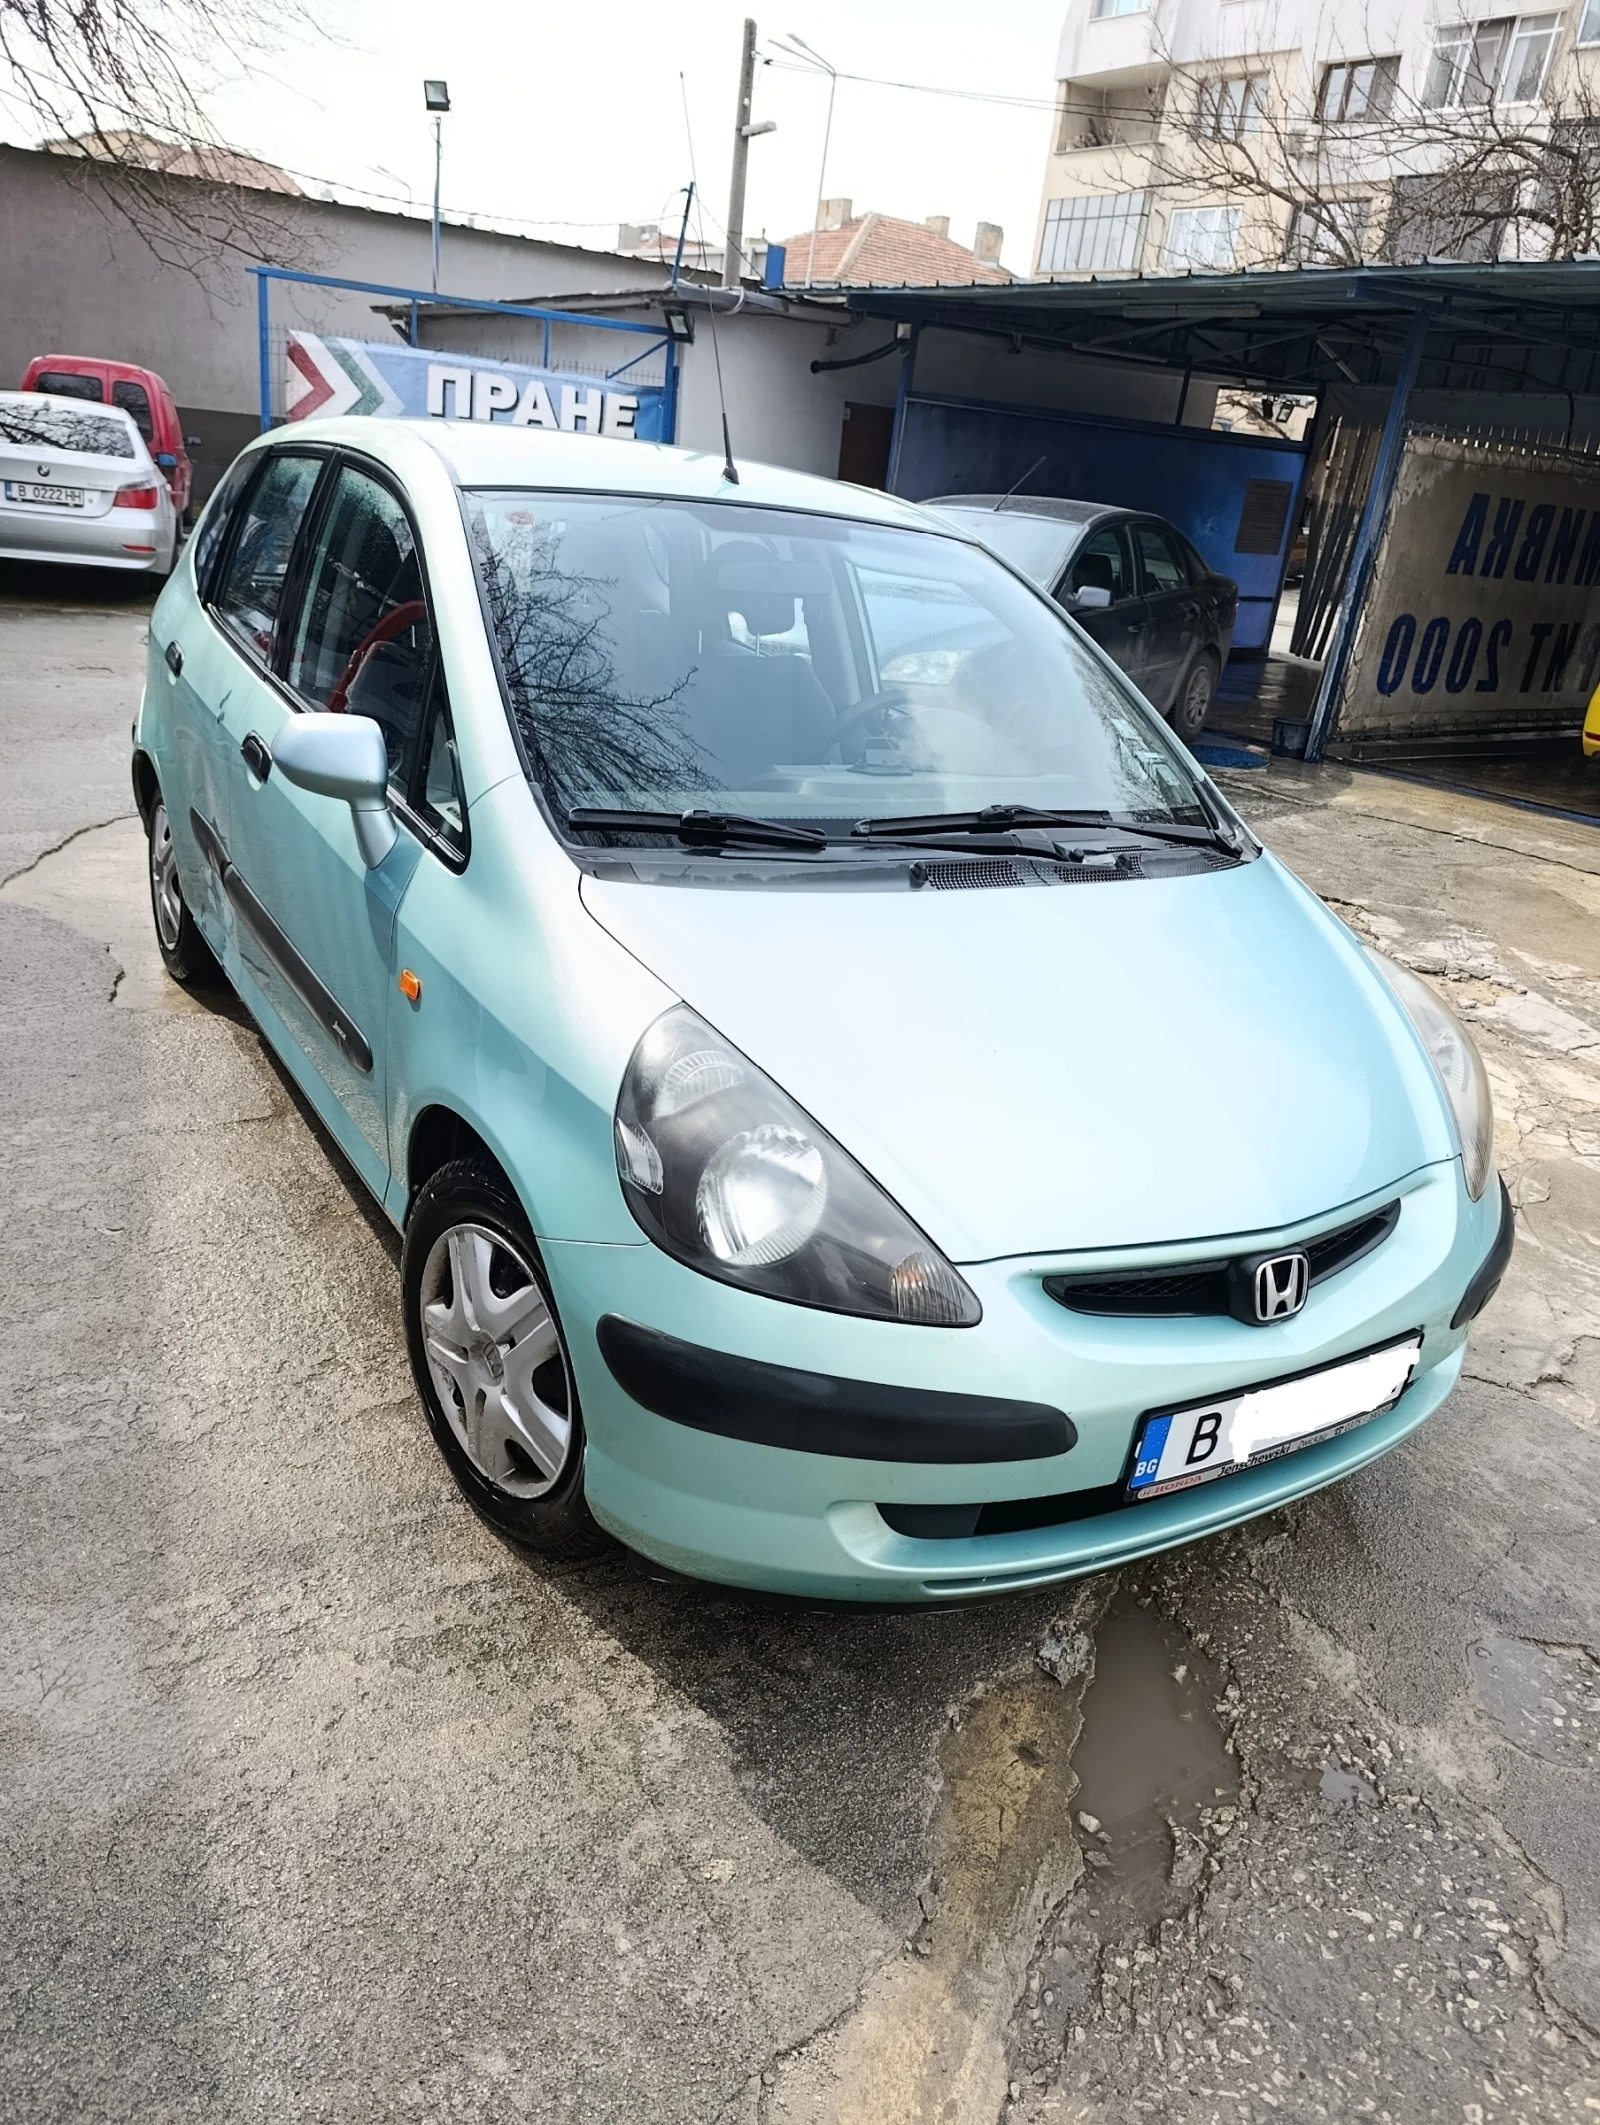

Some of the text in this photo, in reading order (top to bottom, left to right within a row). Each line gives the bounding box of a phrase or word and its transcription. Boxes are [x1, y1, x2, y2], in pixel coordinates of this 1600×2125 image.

[427, 364, 641, 439] ПРАНЕ
[33, 486, 63, 500] 0222
[1135, 1412, 1222, 1477] BG B
[1154, 1475, 1202, 1493] HONDA
[1217, 1443, 1292, 1477] Jenschewski
